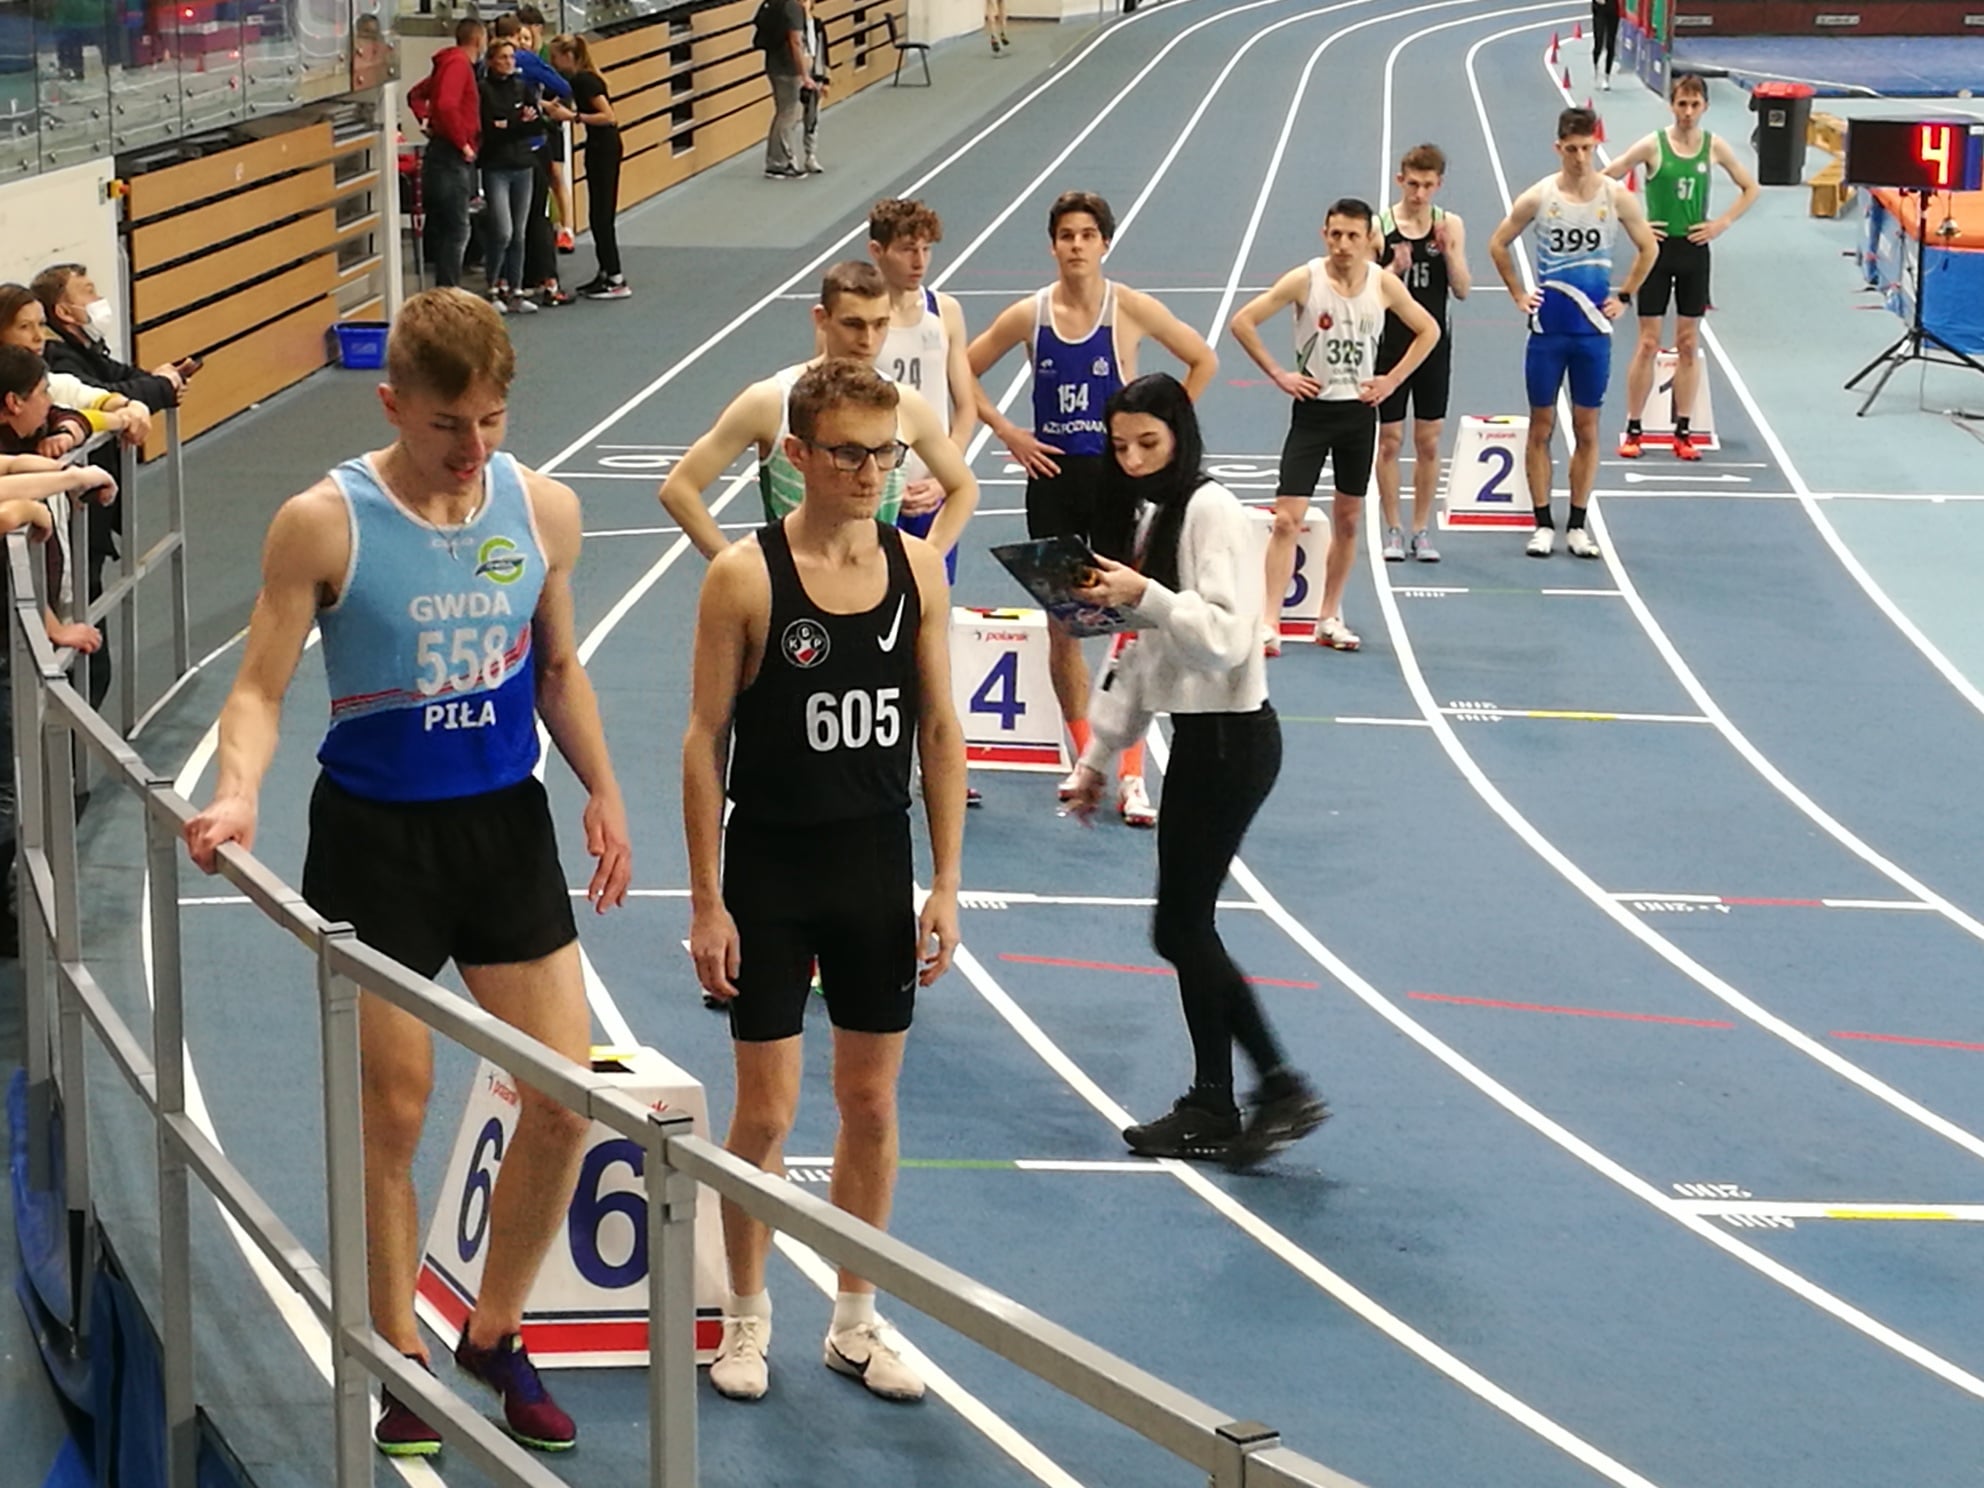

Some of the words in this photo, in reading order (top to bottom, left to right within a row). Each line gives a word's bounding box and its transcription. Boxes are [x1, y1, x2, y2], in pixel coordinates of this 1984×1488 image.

[1920, 125, 1951, 185] 4
[1677, 177, 1696, 200] 57
[1550, 228, 1602, 253] 399
[1326, 339, 1365, 366] 325
[1057, 382, 1090, 414] 154
[1475, 446, 1515, 503] 2
[409, 590, 512, 623] GWDA
[415, 625, 508, 696] 558
[424, 699, 497, 731] PIŁA
[805, 687, 901, 752] 605
[969, 651, 1026, 731] 4
[457, 1116, 505, 1264] 6
[567, 1137, 650, 1289] 6
